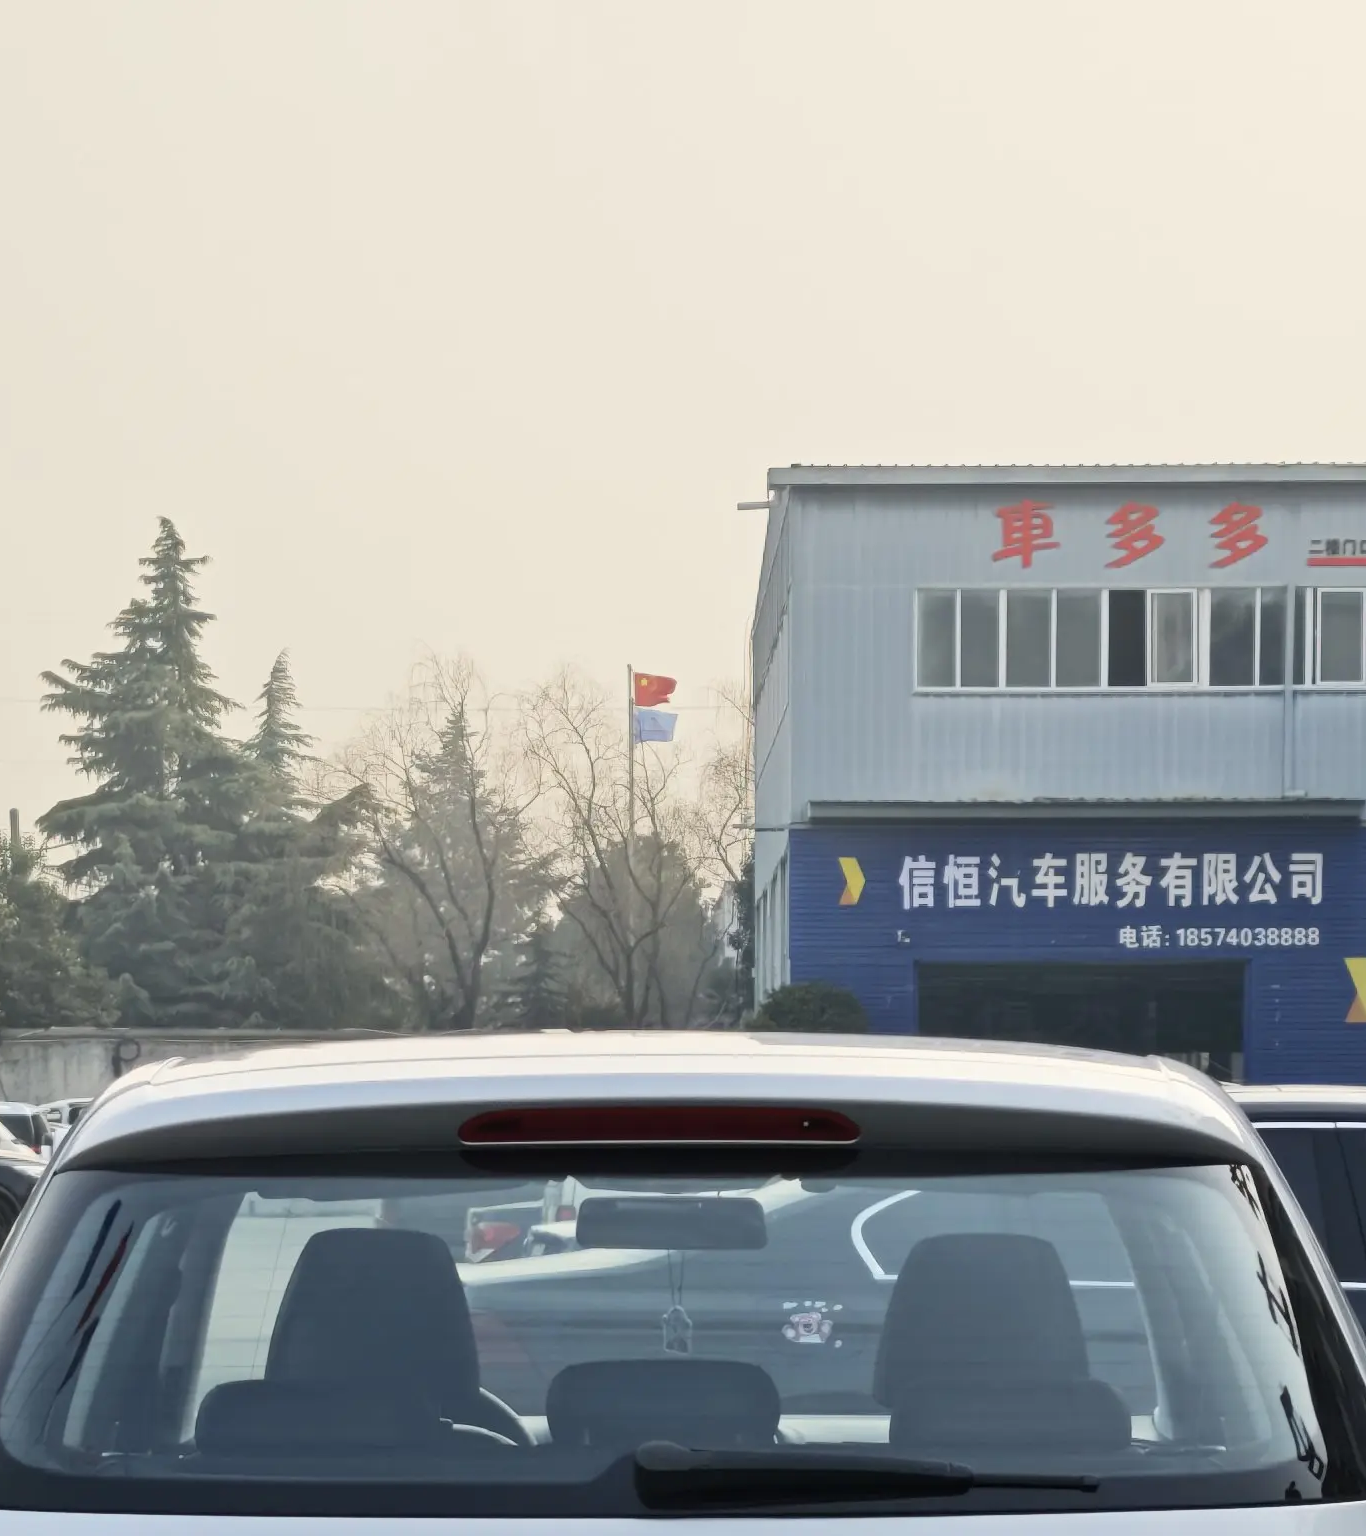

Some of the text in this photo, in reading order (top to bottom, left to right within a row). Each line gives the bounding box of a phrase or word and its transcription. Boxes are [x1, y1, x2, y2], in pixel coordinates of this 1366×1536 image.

[898, 852, 1324, 909] 信恒汽车服务有限公司
[1176, 927, 1321, 947] 18574038888
